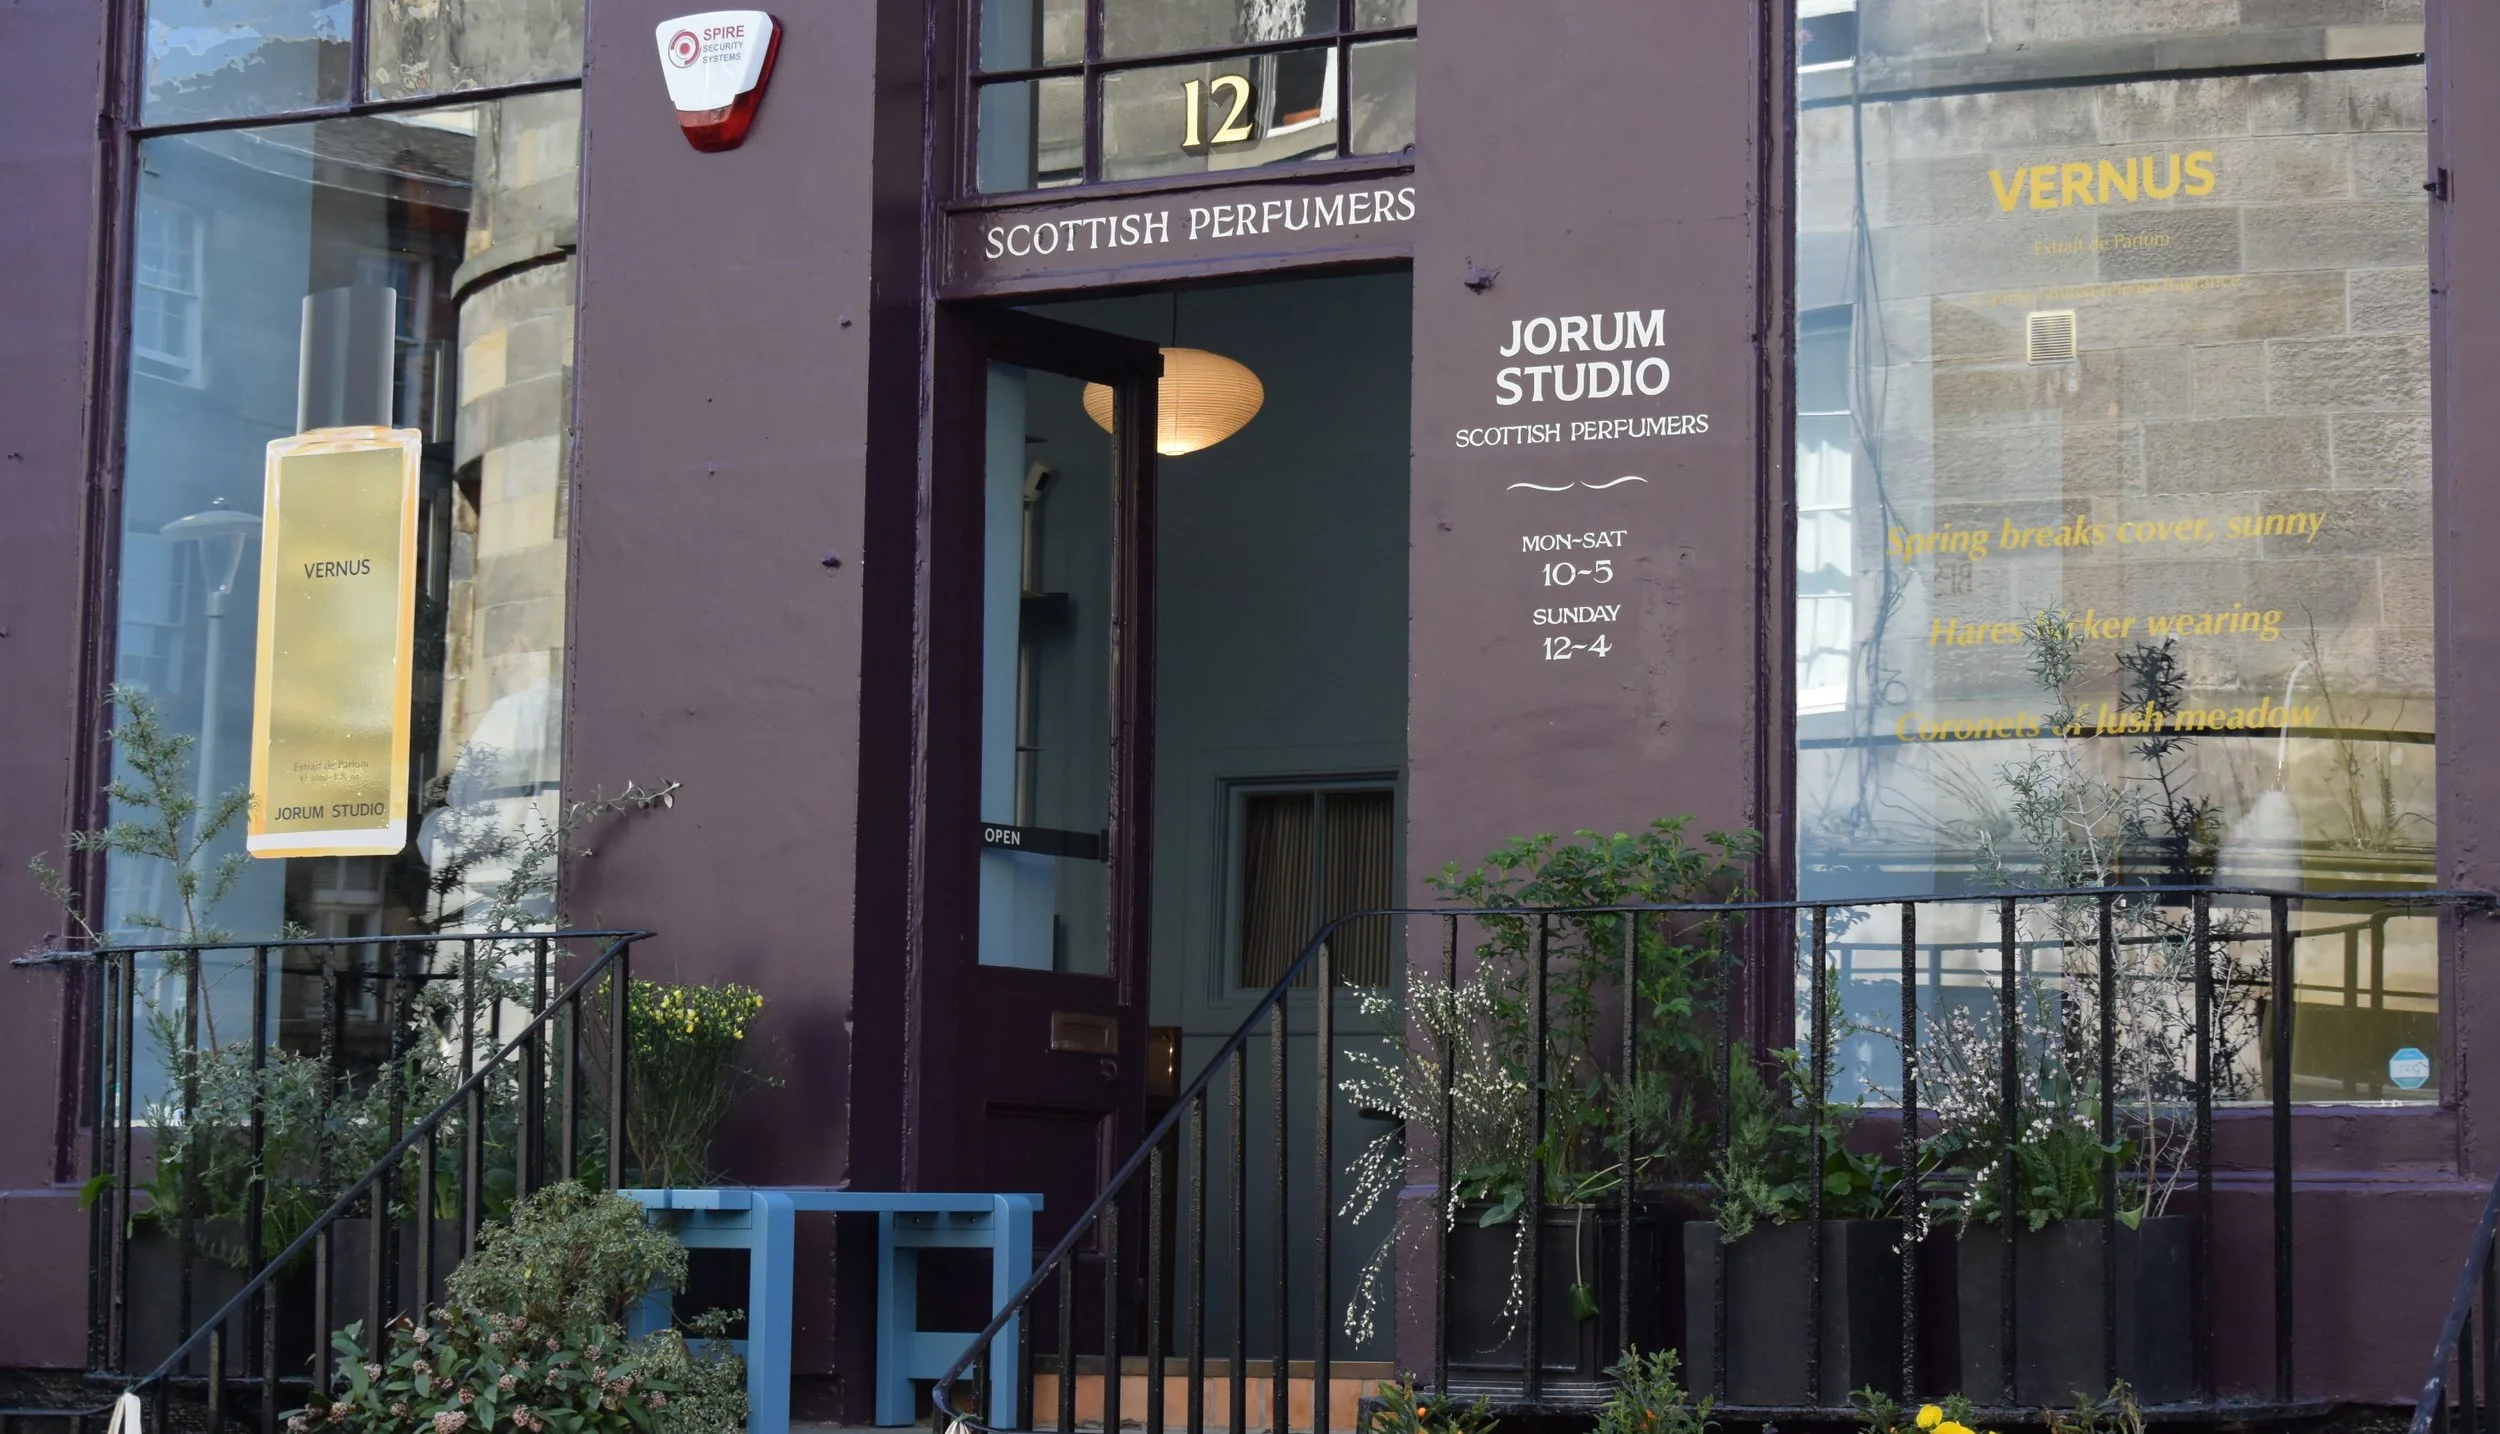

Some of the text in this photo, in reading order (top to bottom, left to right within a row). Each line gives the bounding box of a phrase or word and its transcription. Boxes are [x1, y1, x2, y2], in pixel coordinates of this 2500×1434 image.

[702, 41, 743, 53] SECURITY
[703, 25, 744, 41] SPIRE
[702, 52, 741, 64] SYSTEMS
[1181, 74, 1254, 150] 12
[1988, 150, 2216, 212] VERNUS
[985, 187, 1416, 259] SCOTTISH PERFUMERS
[2034, 231, 2170, 256] Extrait de Parfum
[1500, 309, 1665, 357] JORUM
[1496, 357, 1670, 406] STUDIO
[1456, 414, 1709, 448] SCOTTISH PERFUMERS
[1887, 511, 2327, 565] Spring breaks cover, sunny
[304, 559, 370, 579] VERNUS
[1533, 604, 1621, 625] SUNDAY
[1930, 616, 2023, 647] Hares
[2148, 602, 2283, 642] wearing
[1896, 711, 2041, 742] Coronets
[2096, 699, 2164, 735] lush
[2174, 696, 2319, 732] meadow
[275, 802, 385, 821] JORUM STUDIO
[985, 828, 1020, 845] OPEN
[2399, 1061, 2421, 1076] ring
